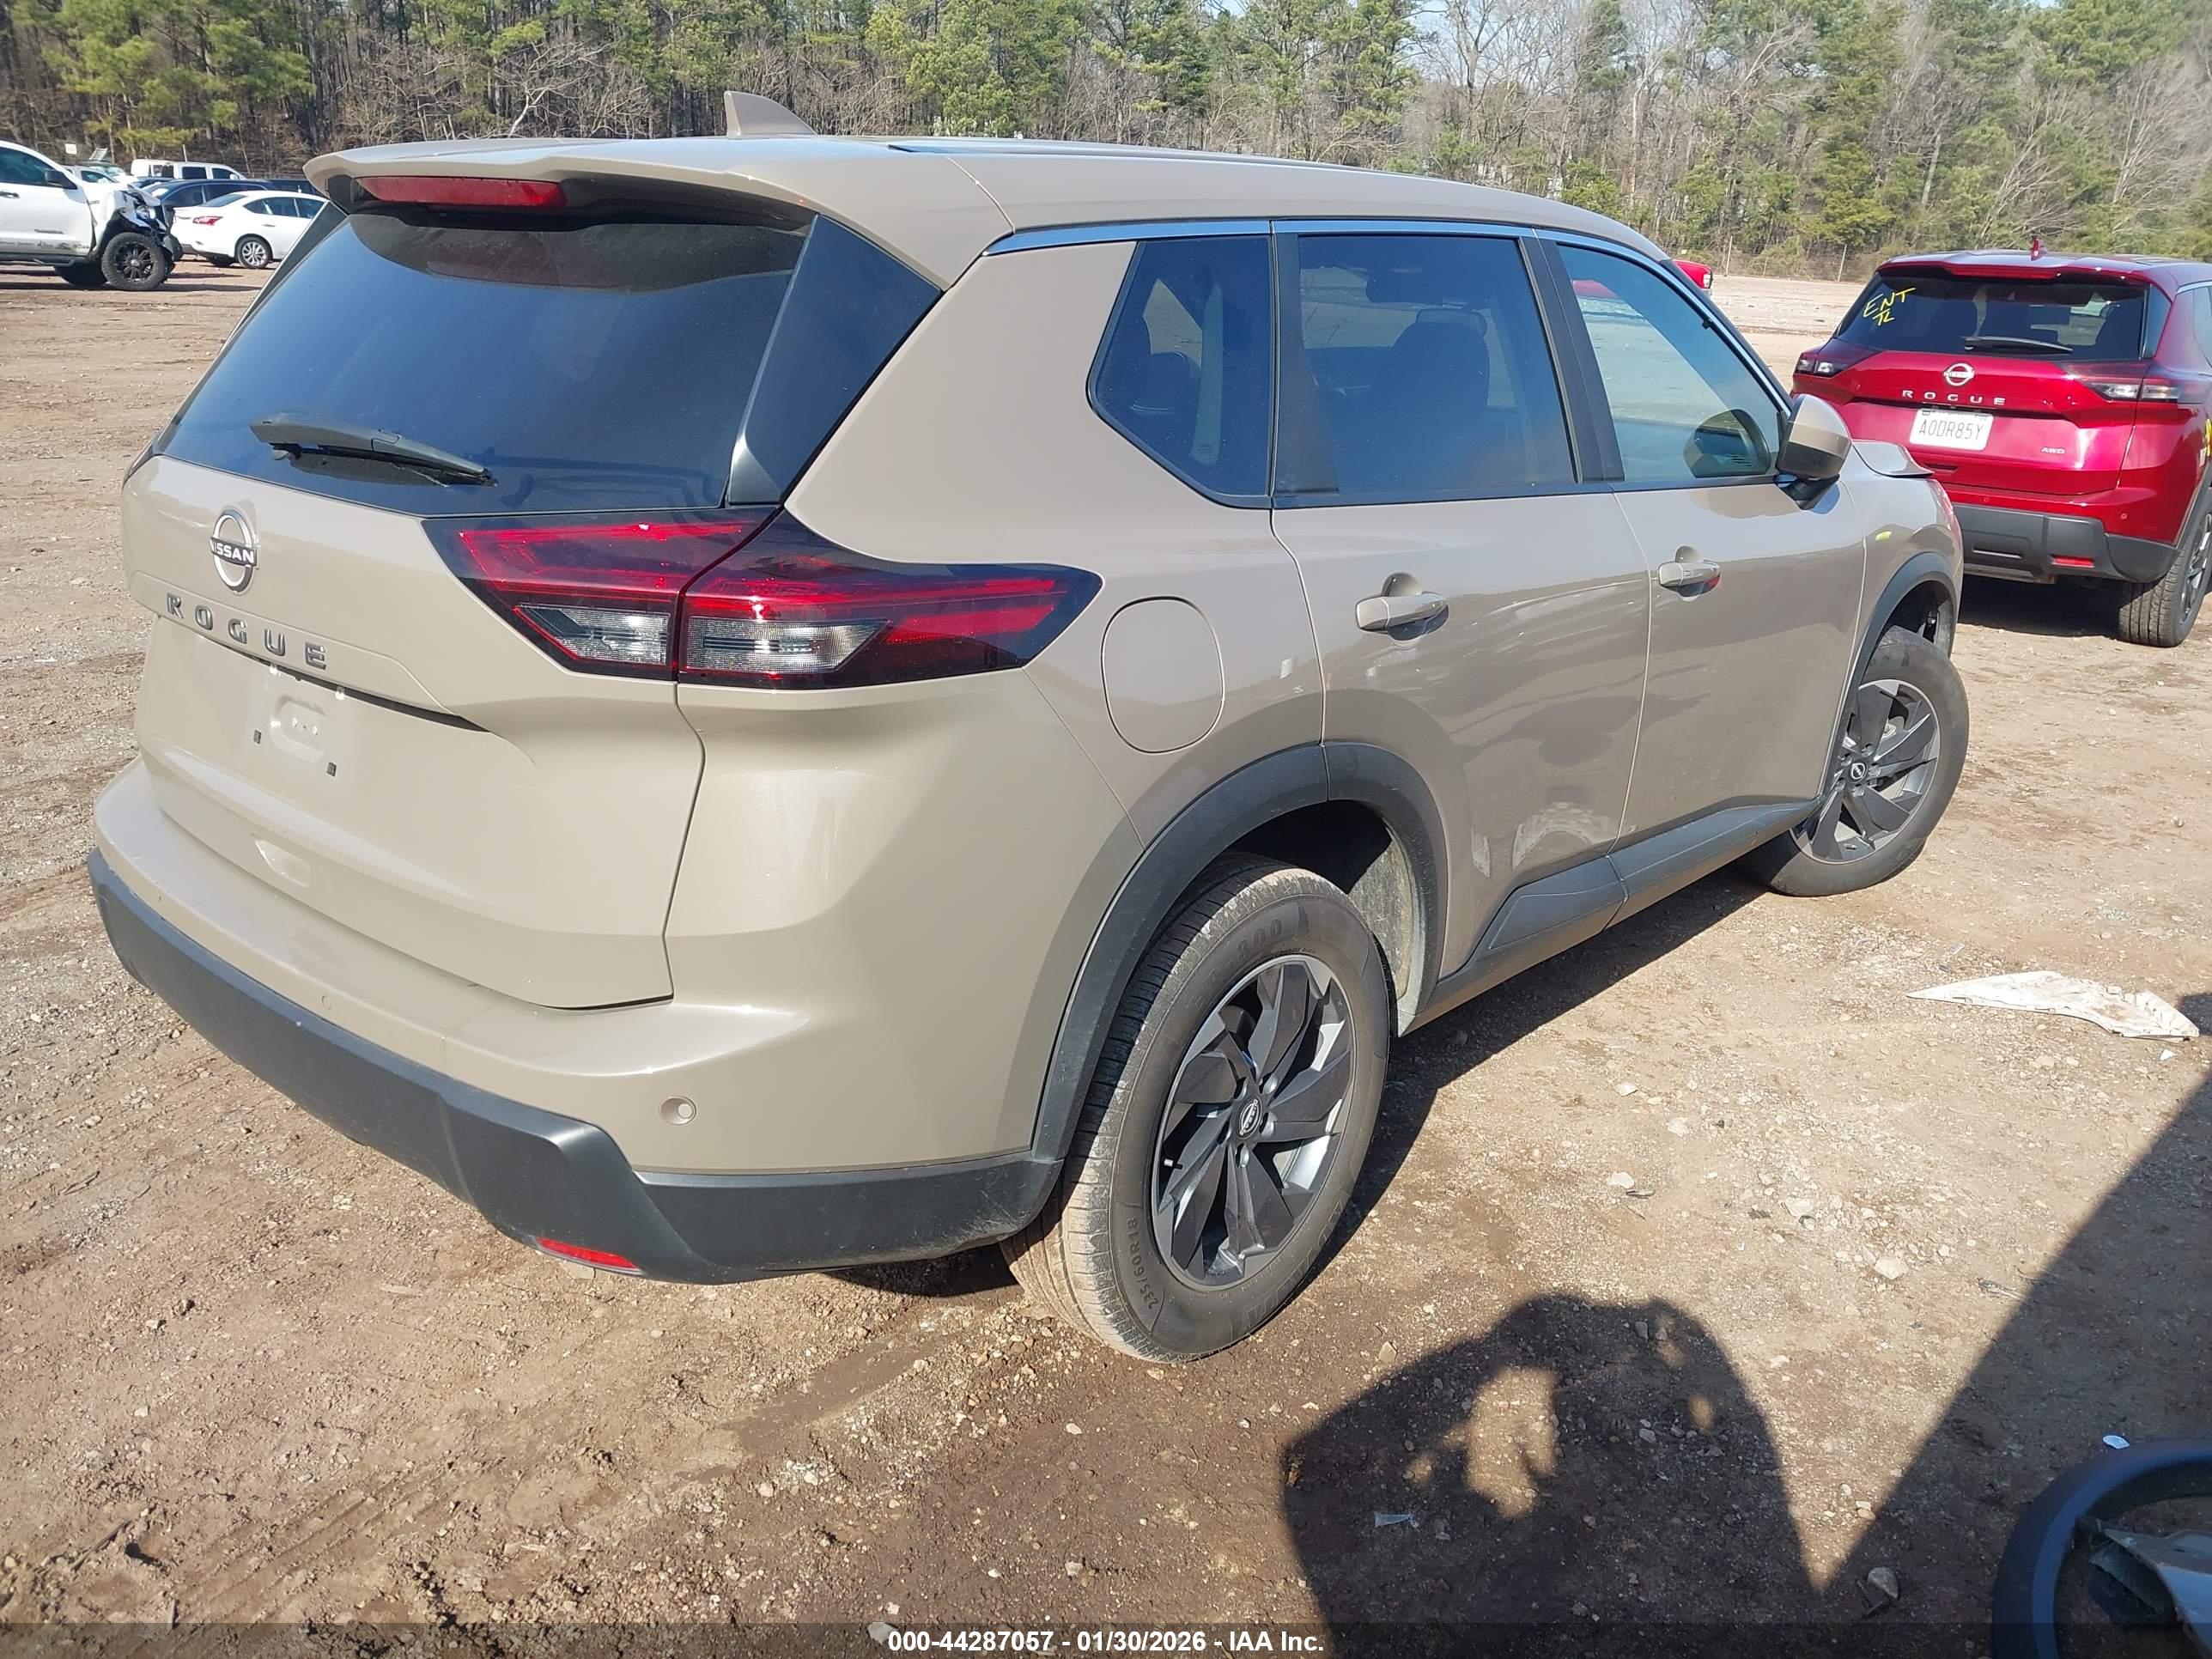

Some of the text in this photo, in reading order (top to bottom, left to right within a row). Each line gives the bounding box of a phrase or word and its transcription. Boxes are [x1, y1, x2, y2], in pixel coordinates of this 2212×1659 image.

[1863, 288, 1916, 317] ENT
[1901, 390, 2006, 405] ROGUE
[167, 592, 327, 670] ROGUE
[1126, 1216, 1159, 1310] 235/60R18
